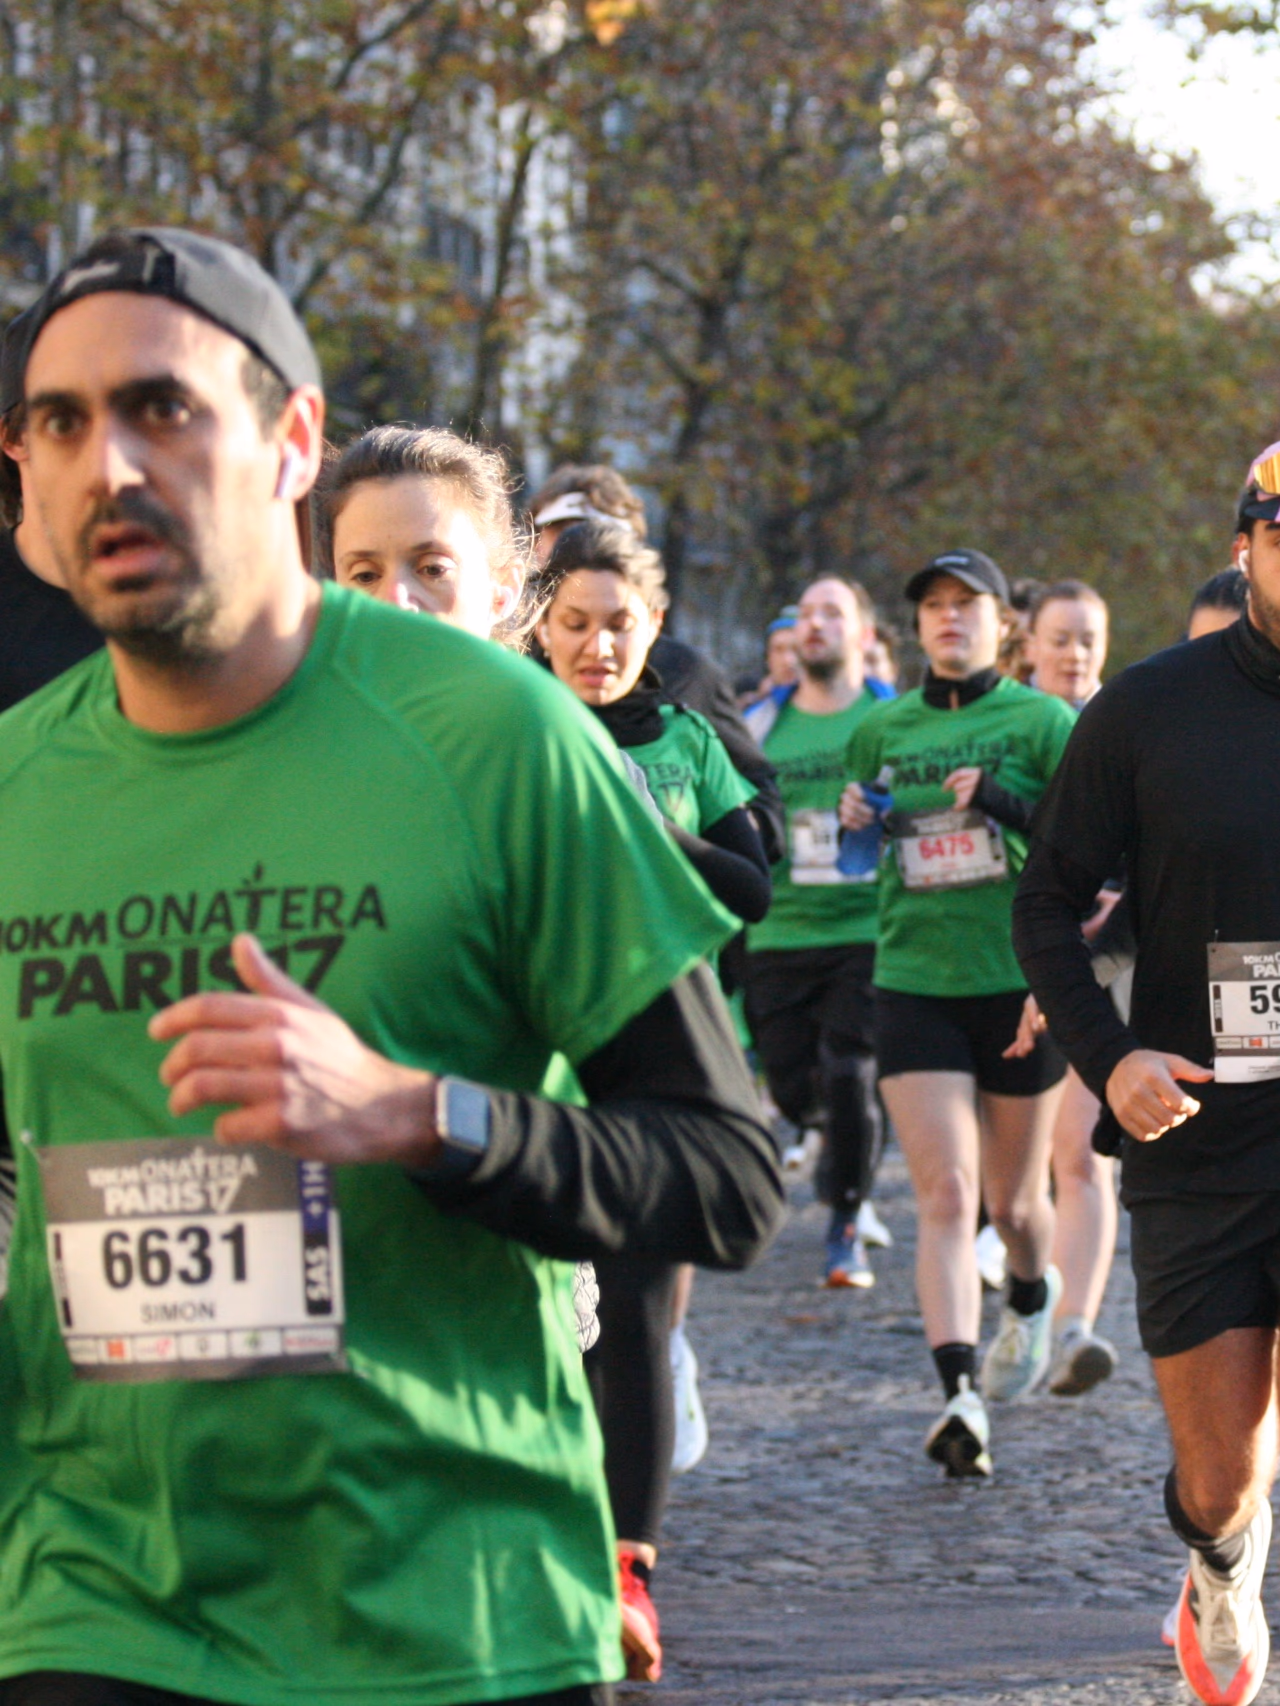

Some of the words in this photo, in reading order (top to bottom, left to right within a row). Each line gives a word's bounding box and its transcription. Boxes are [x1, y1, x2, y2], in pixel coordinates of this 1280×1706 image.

[0, 911, 108, 954] 0KM
[117, 882, 388, 940] ONATERA
[103, 1222, 247, 1290] 6631
[140, 1301, 216, 1324] SIMON
